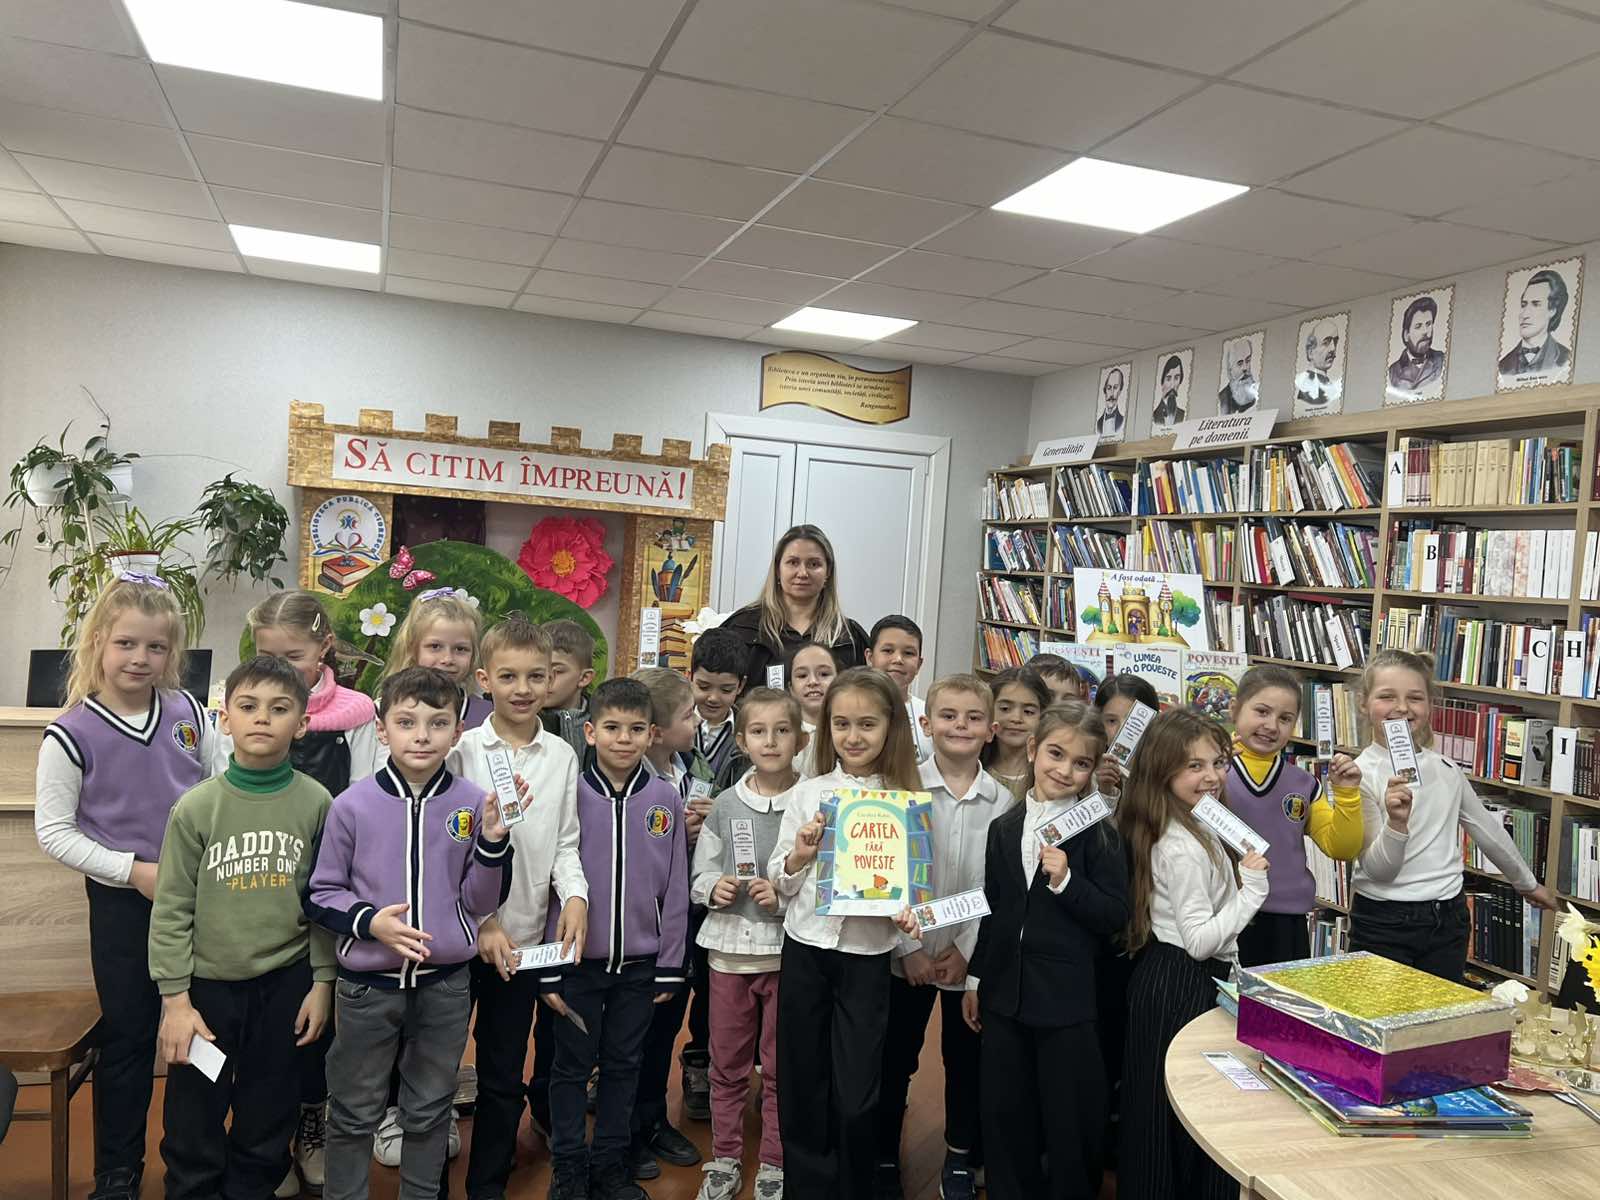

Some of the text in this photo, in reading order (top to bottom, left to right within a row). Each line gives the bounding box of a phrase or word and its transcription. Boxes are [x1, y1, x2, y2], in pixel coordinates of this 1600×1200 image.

[1198, 416, 1252, 431] Literatura
[1188, 427, 1249, 448] pe domenii.
[344, 438, 686, 499] SĂ CITIM ÎMPREUNĂ!
[1390, 461, 1401, 475] A
[312, 501, 334, 549] BIBLIOTECA
[371, 512, 384, 553] CIORESCU
[1426, 545, 1437, 560] B
[1118, 573, 1133, 582] fost
[1134, 575, 1156, 583] odată
[1532, 640, 1547, 658] C
[1567, 640, 1582, 658] H
[1134, 653, 1161, 664] LUMEA
[1133, 664, 1140, 673] O
[1141, 663, 1178, 680] POVESTE
[1560, 737, 1568, 755] I
[850, 822, 899, 839] CARTEA
[207, 830, 304, 870] DADDY'S
[216, 857, 297, 882] NUMBER ONE
[854, 854, 896, 870] POVESTE
